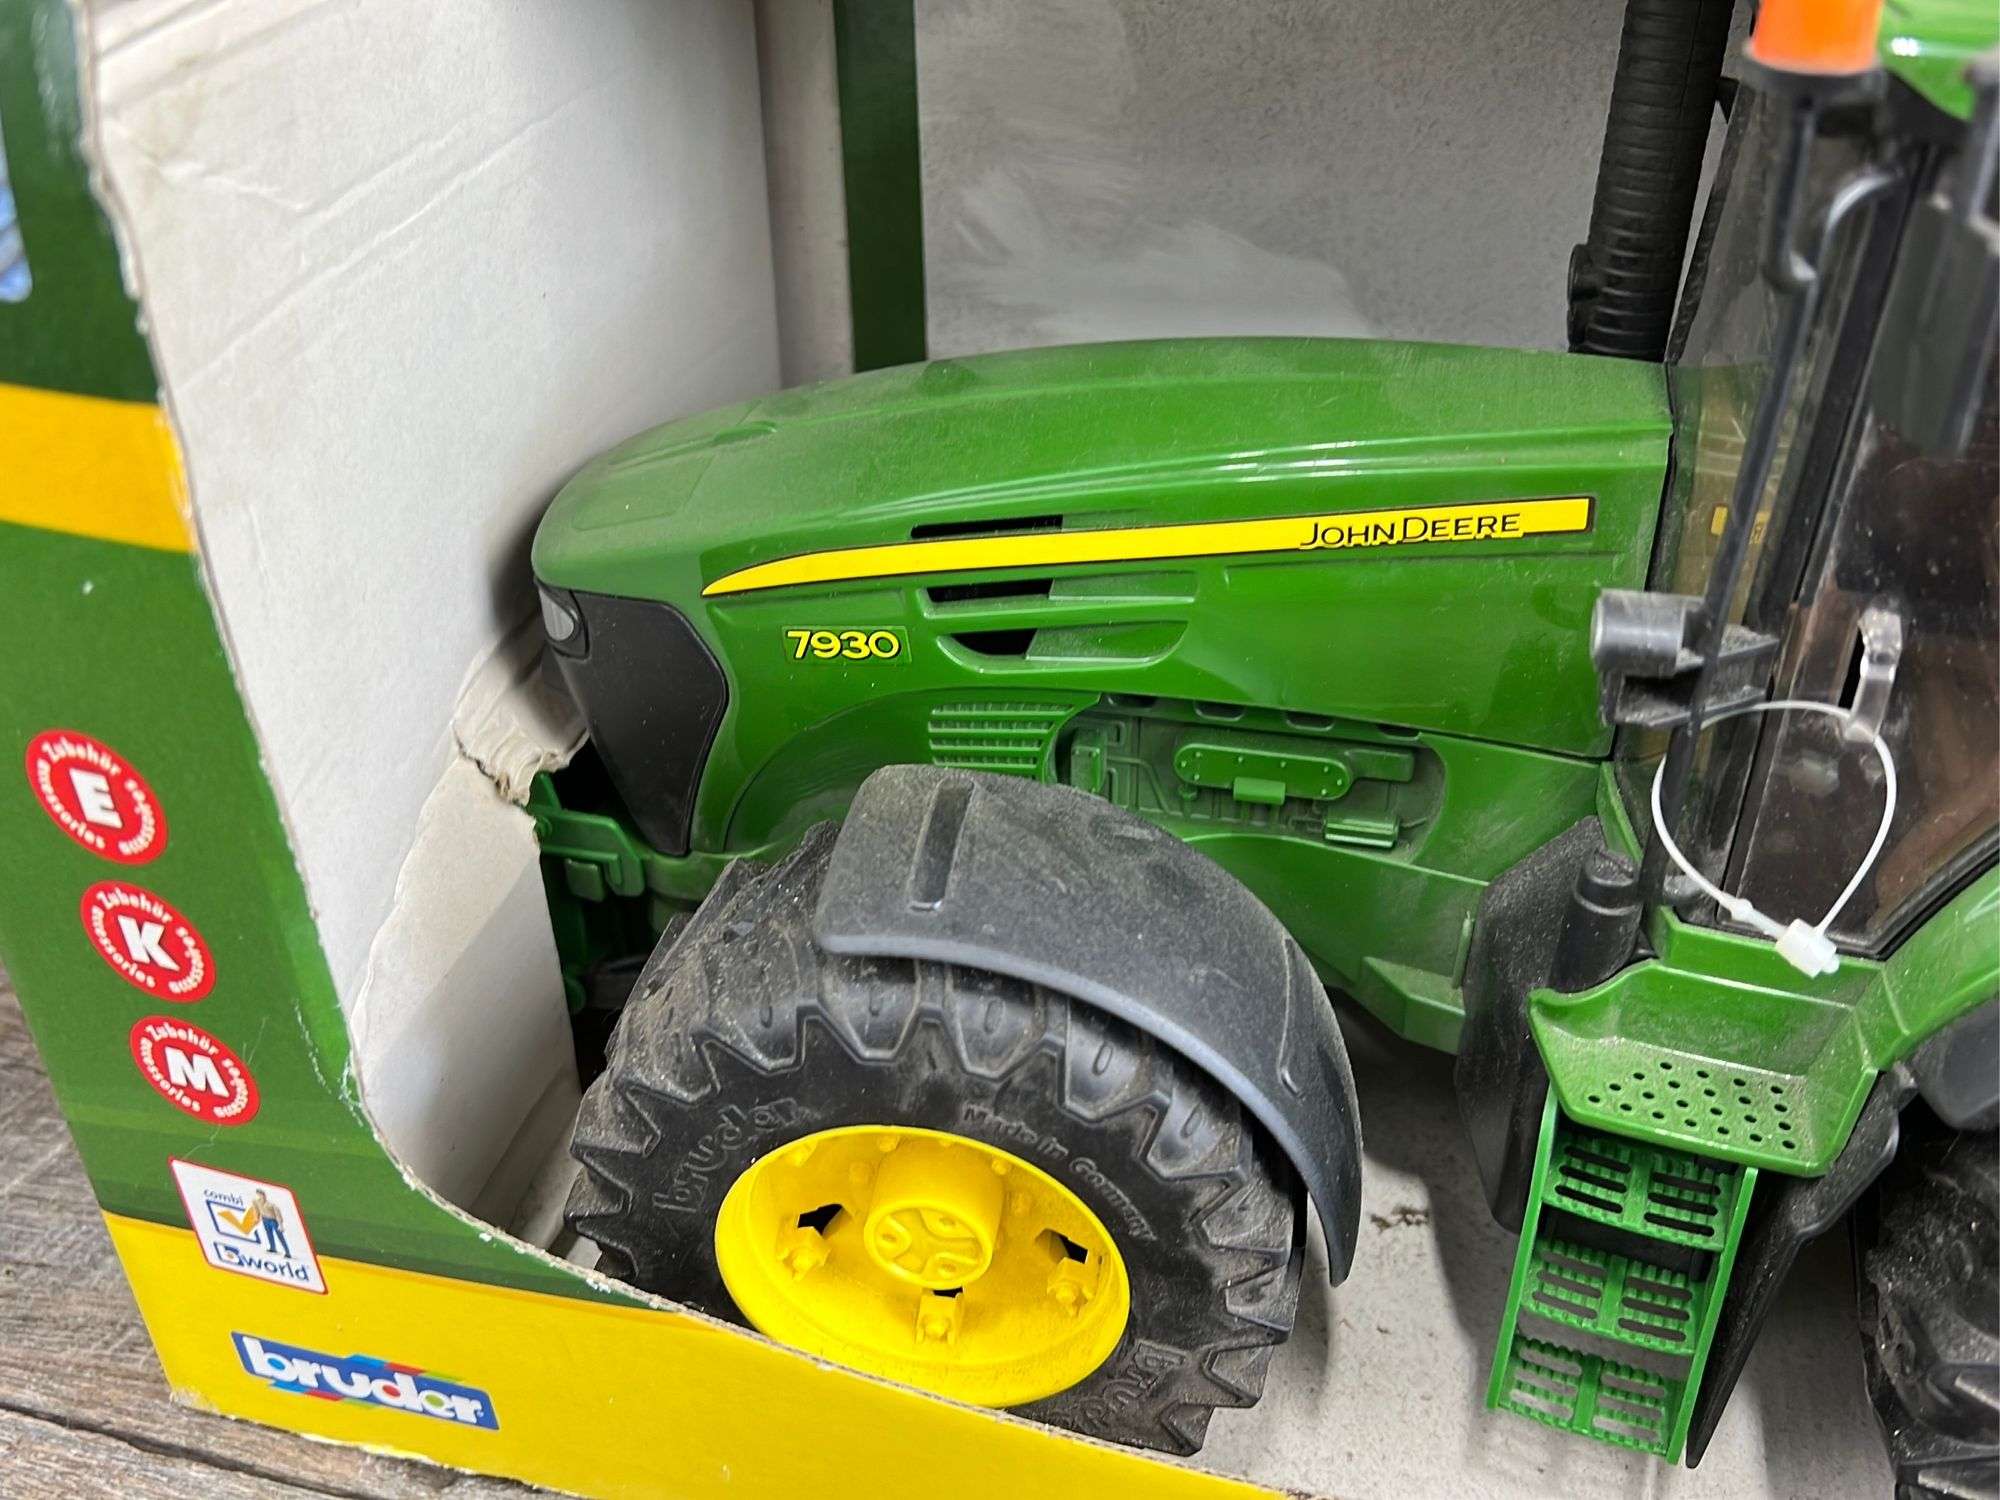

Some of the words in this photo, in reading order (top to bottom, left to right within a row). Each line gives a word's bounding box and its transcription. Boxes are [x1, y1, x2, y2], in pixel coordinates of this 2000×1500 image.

[1301, 522, 1396, 546] JOHN
[1403, 513, 1521, 540] DEERE
[786, 629, 902, 660] 7930
[69, 767, 124, 829] E
[117, 914, 181, 972] K
[143, 1021, 220, 1056] Zubehör
[164, 1046, 230, 1098] M
[203, 1188, 245, 1206] combi
[242, 1336, 485, 1424] bruder
